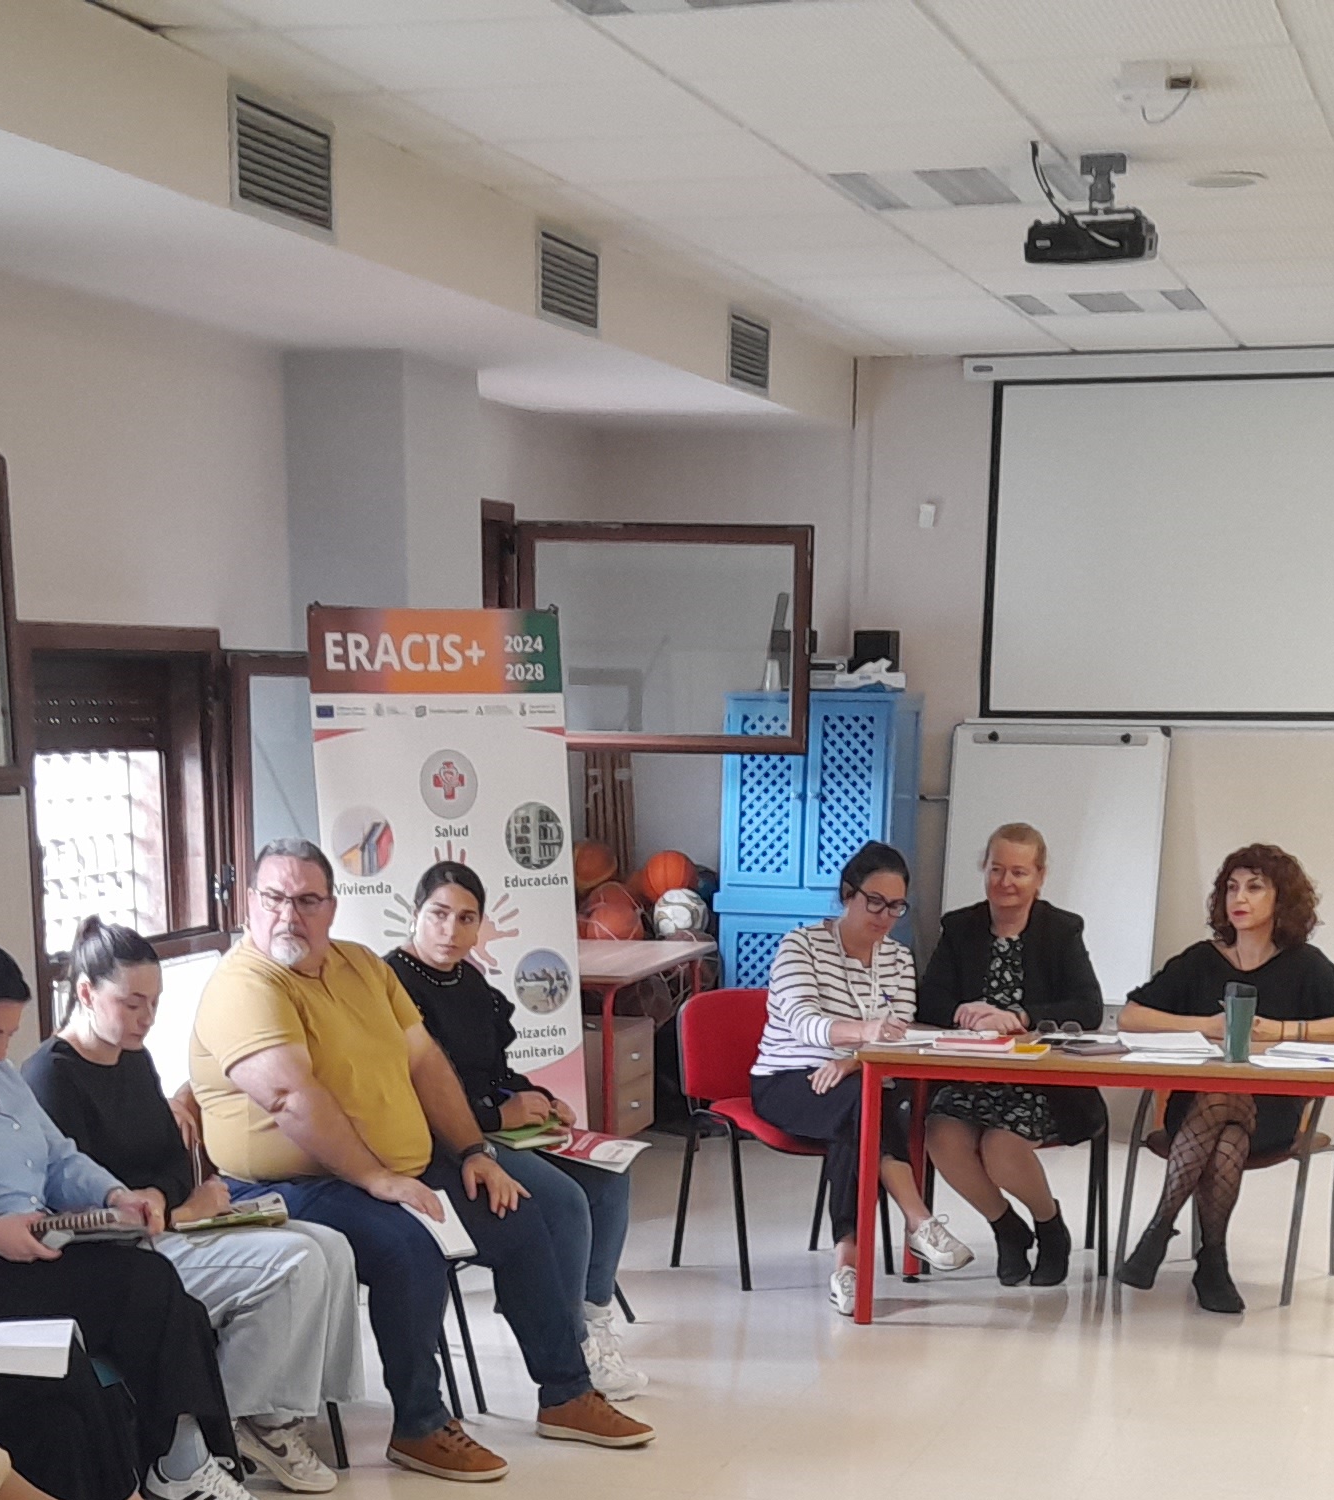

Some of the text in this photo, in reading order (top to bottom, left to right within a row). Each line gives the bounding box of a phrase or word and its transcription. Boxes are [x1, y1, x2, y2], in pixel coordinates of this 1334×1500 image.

[323, 630, 486, 672] ERACIS+
[504, 635, 545, 653] 2024
[505, 663, 546, 681] 2028
[434, 824, 469, 838] Salud
[333, 881, 392, 896] Vivienda
[503, 873, 569, 889] Educación
